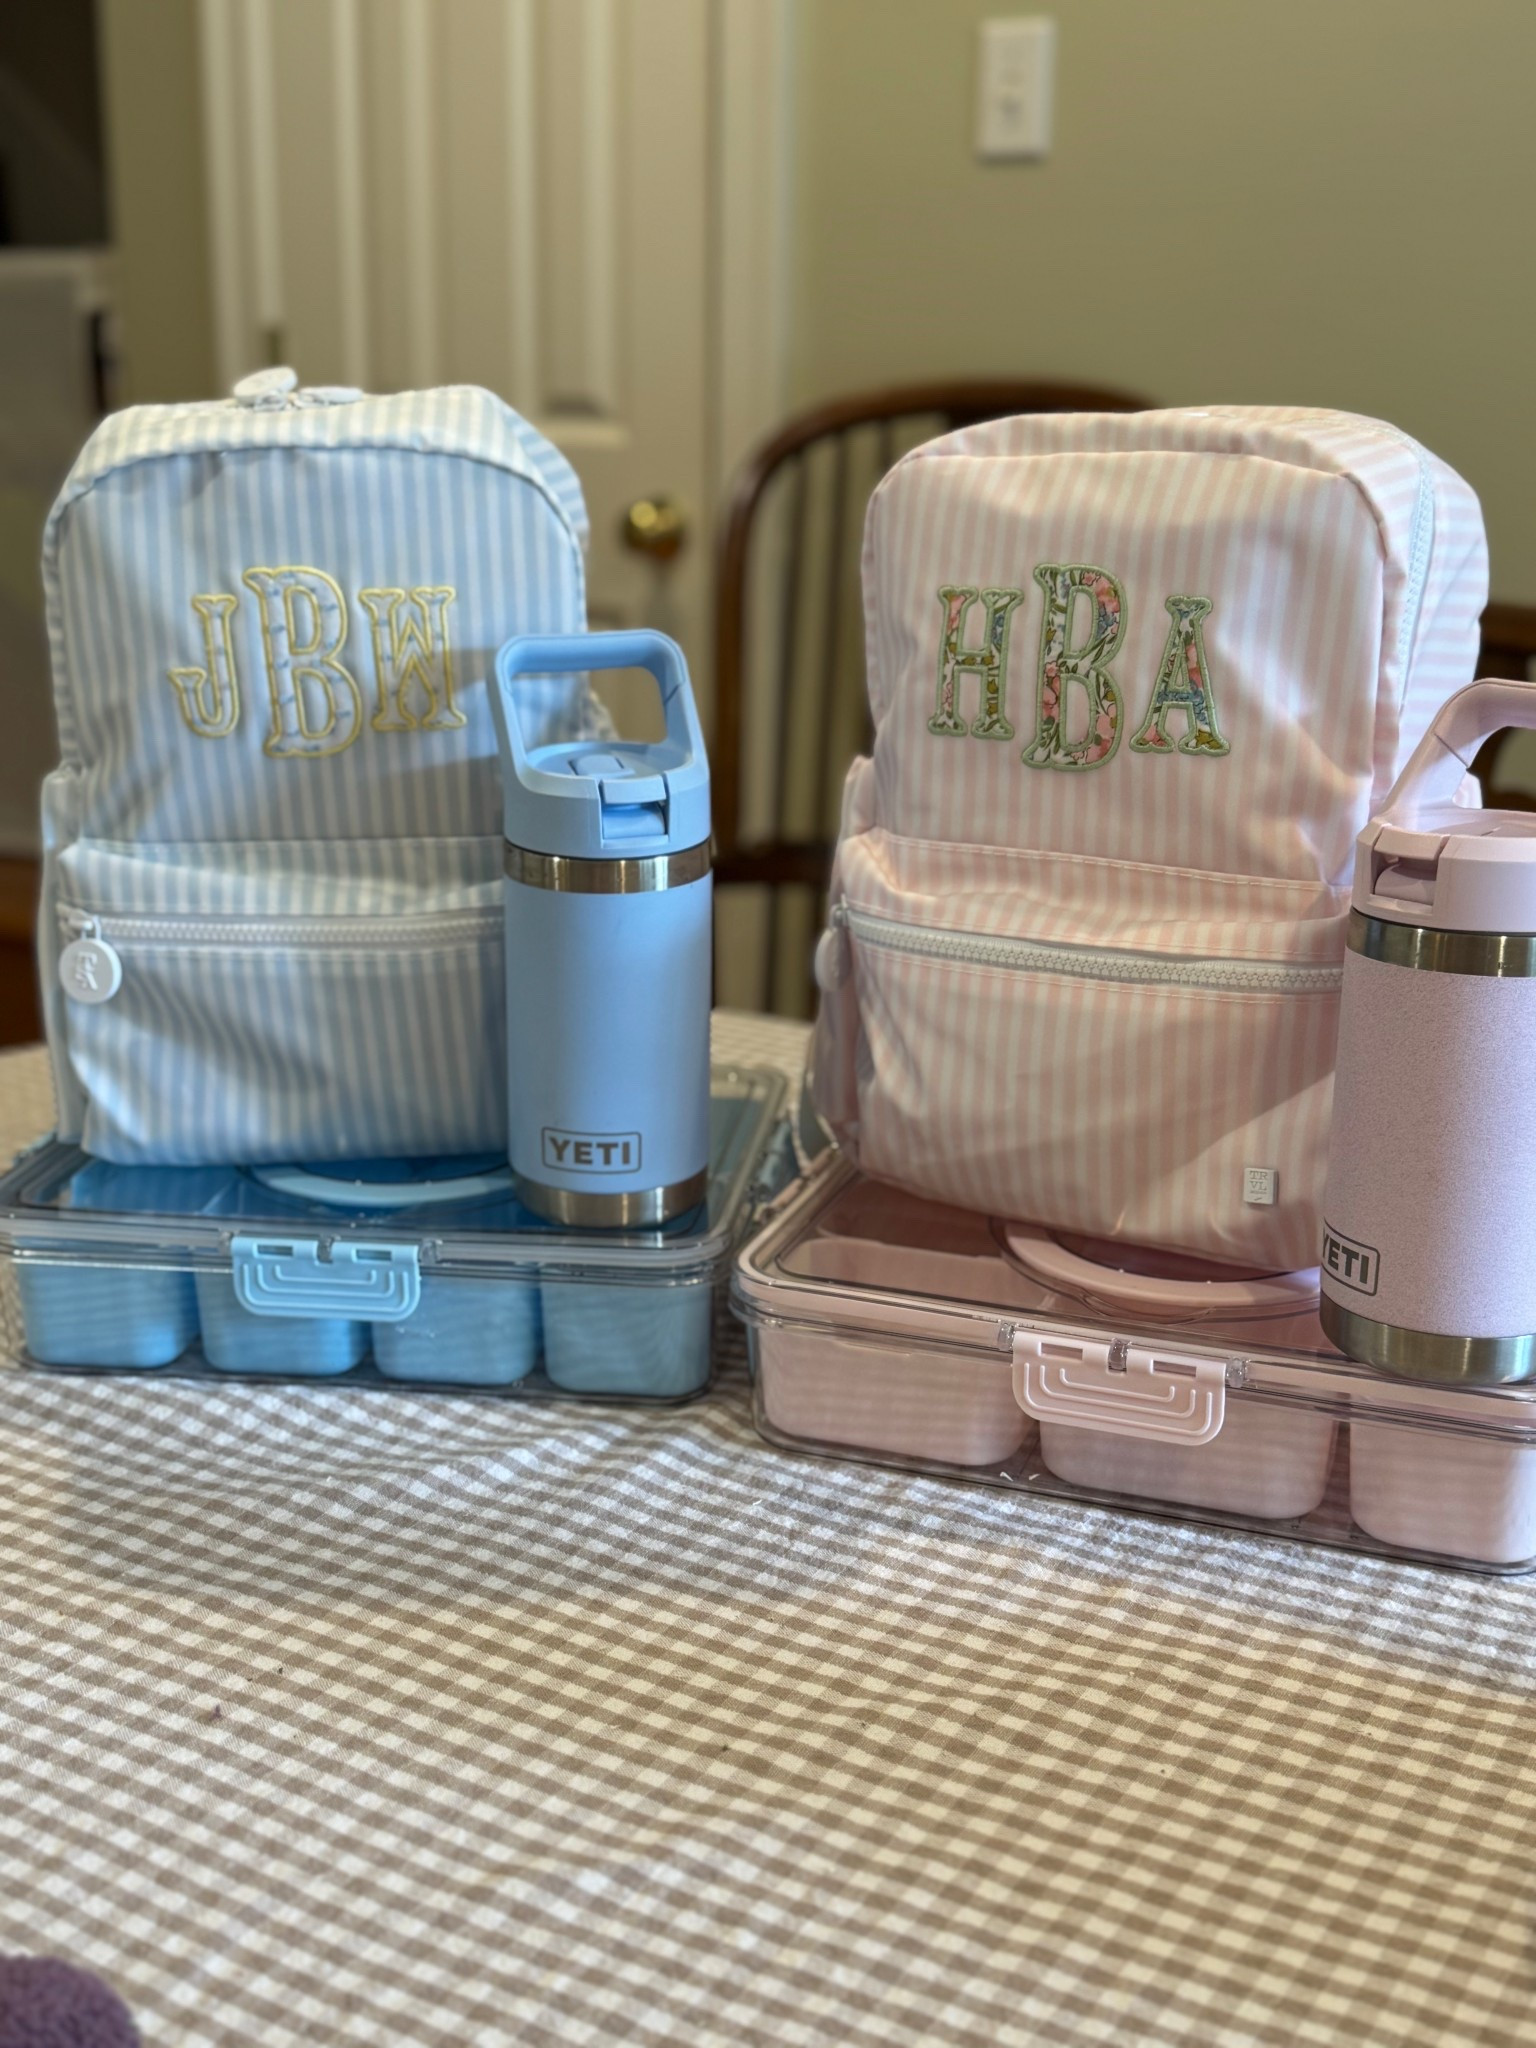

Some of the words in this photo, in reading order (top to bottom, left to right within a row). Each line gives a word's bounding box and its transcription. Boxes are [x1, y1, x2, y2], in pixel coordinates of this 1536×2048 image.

[167, 565, 467, 757] JBW
[927, 563, 1230, 771] HBA
[549, 1136, 630, 1165] YETI
